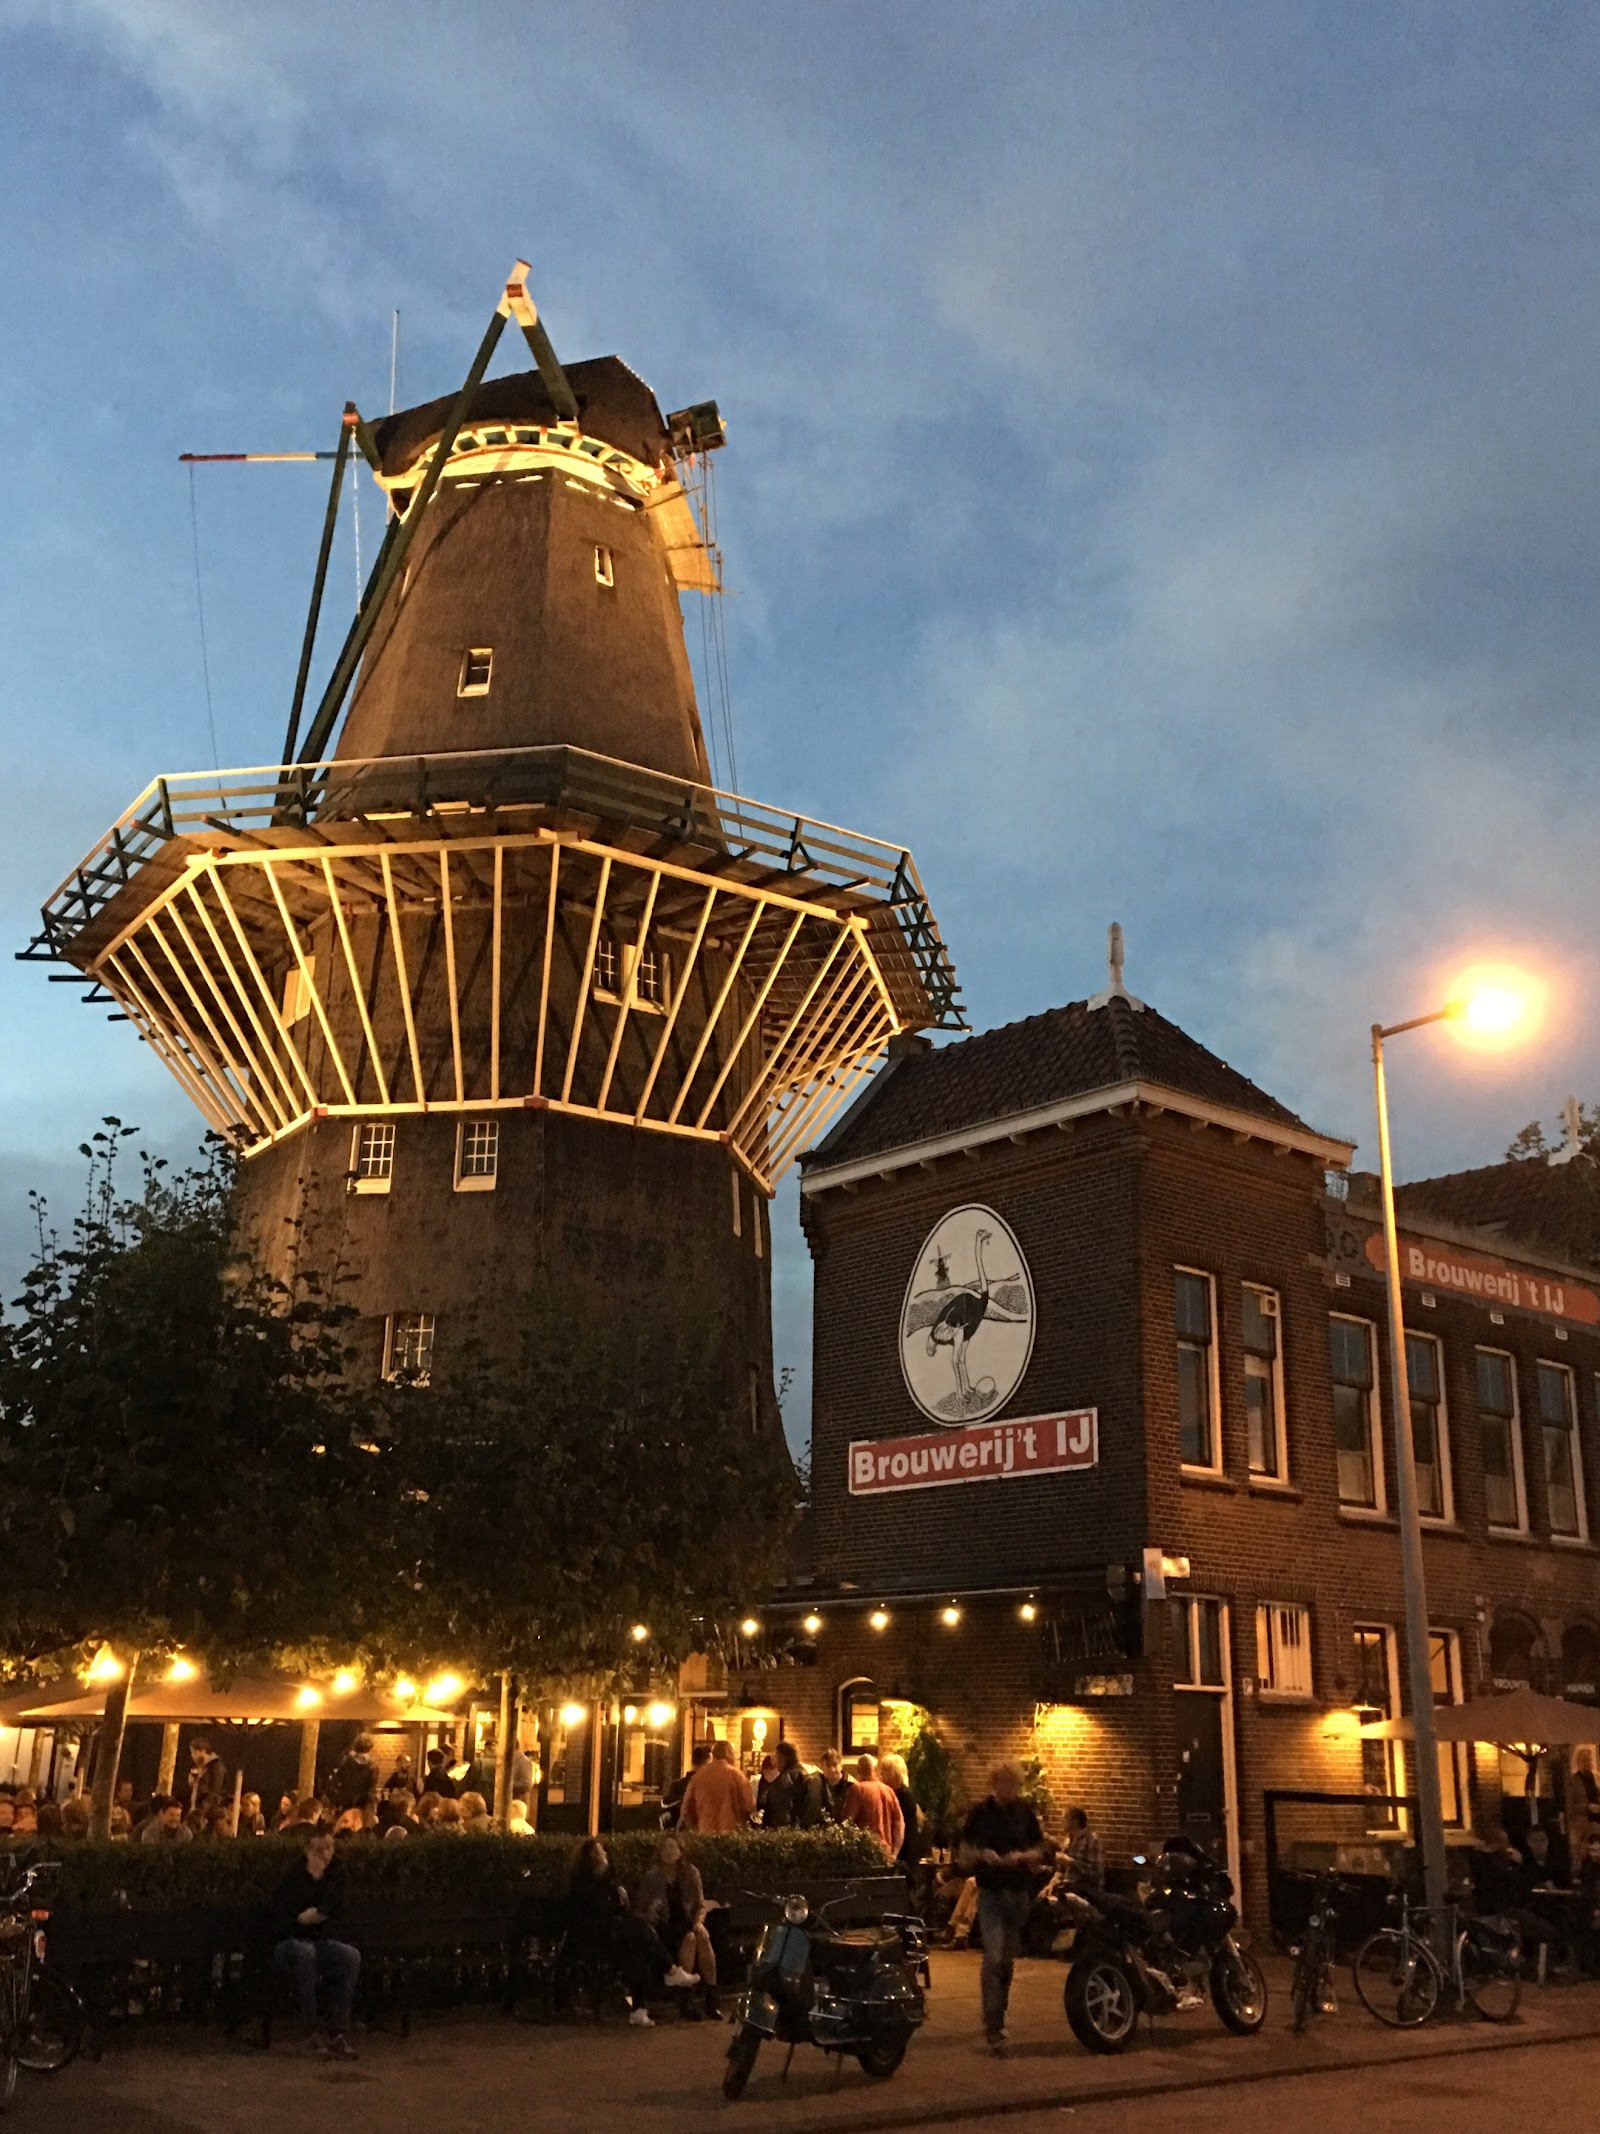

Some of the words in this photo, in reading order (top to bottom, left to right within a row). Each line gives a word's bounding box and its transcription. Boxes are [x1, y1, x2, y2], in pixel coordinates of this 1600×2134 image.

[1408, 1247, 1520, 1306] Brouwerij
[1544, 1285, 1565, 1314] IJ
[1056, 1416, 1091, 1456] IJ
